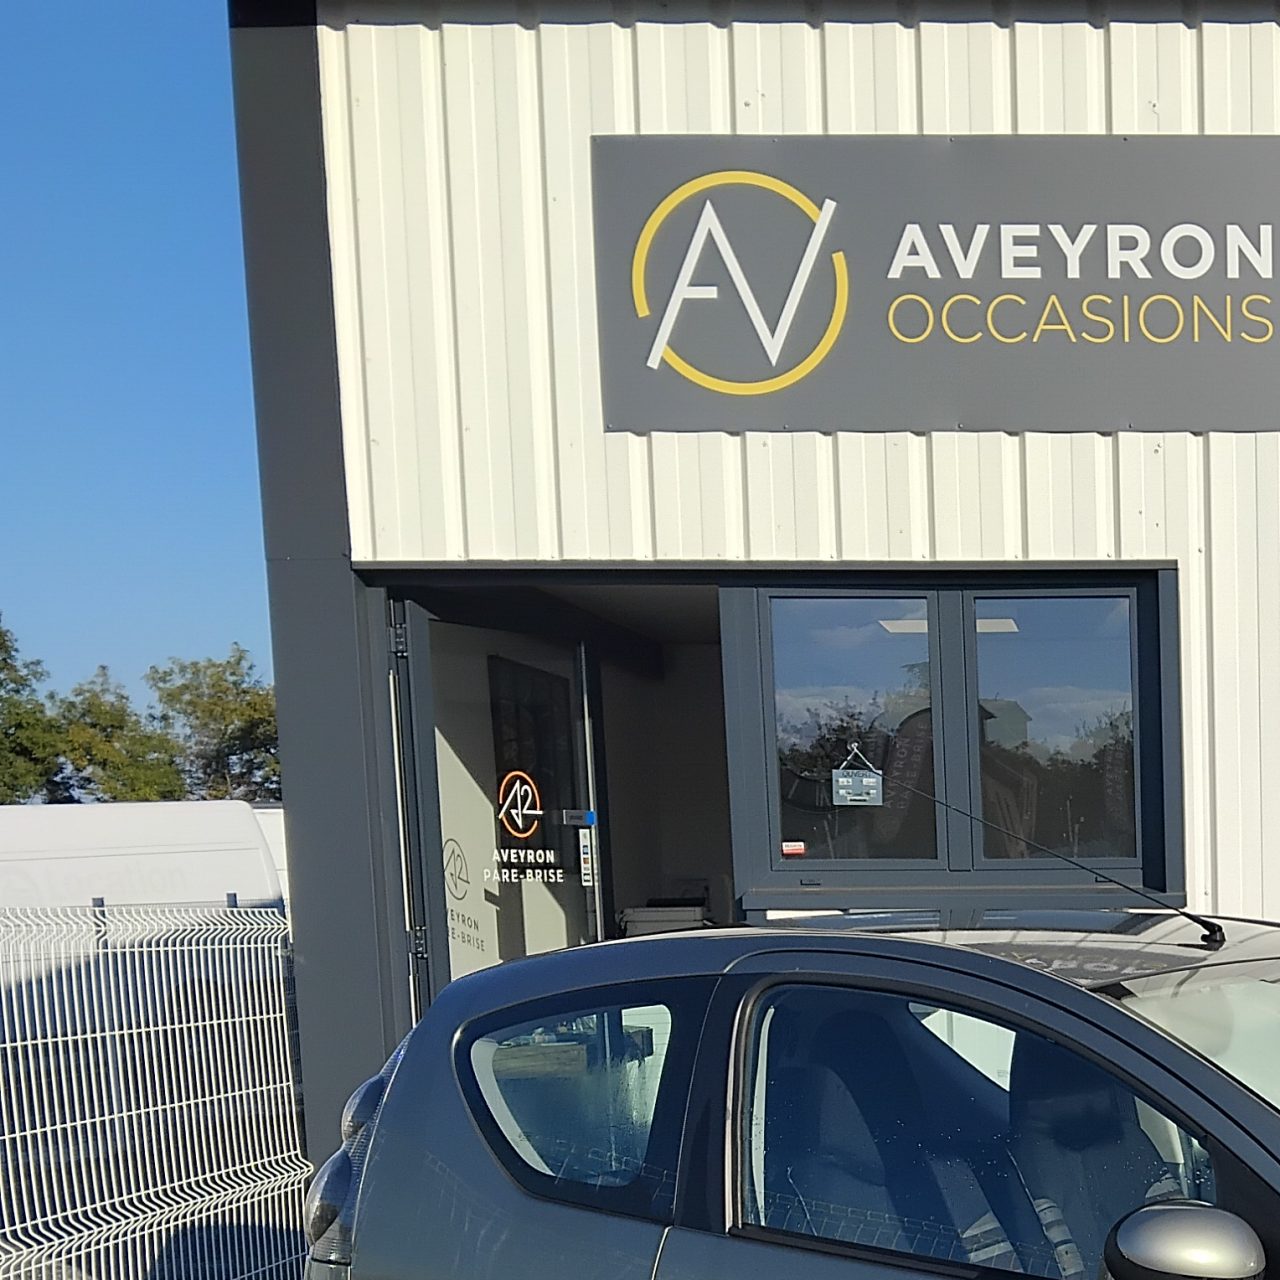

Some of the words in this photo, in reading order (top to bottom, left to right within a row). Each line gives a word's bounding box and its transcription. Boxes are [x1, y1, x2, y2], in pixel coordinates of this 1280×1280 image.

[887, 223, 1273, 279] AVEYRON
[887, 294, 1274, 344] OCCASIONS
[492, 848, 555, 863] AVEYRON
[483, 868, 564, 883] PARE-BRISE
